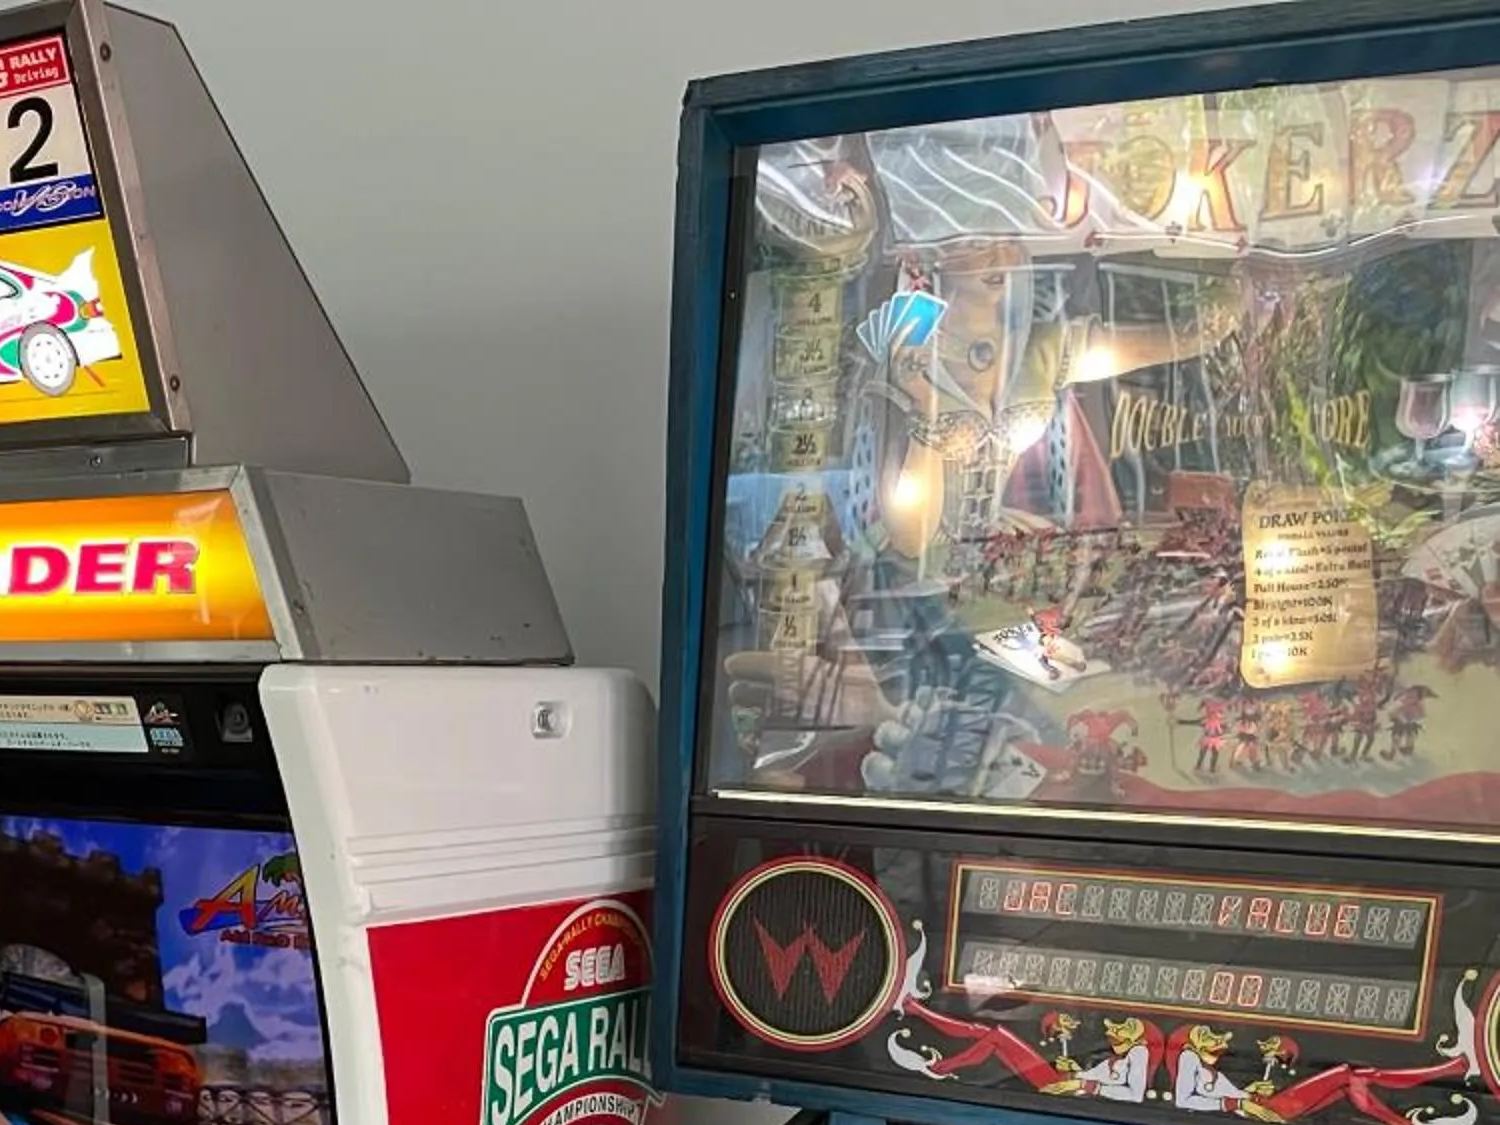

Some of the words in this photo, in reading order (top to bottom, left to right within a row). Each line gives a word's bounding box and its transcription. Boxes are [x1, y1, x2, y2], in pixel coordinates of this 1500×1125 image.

[10, 47, 57, 70] RALLY
[8, 97, 59, 184] 2
[1259, 511, 1308, 529] DRAW
[563, 943, 626, 991] SEGA
[588, 997, 653, 1082] RALL
